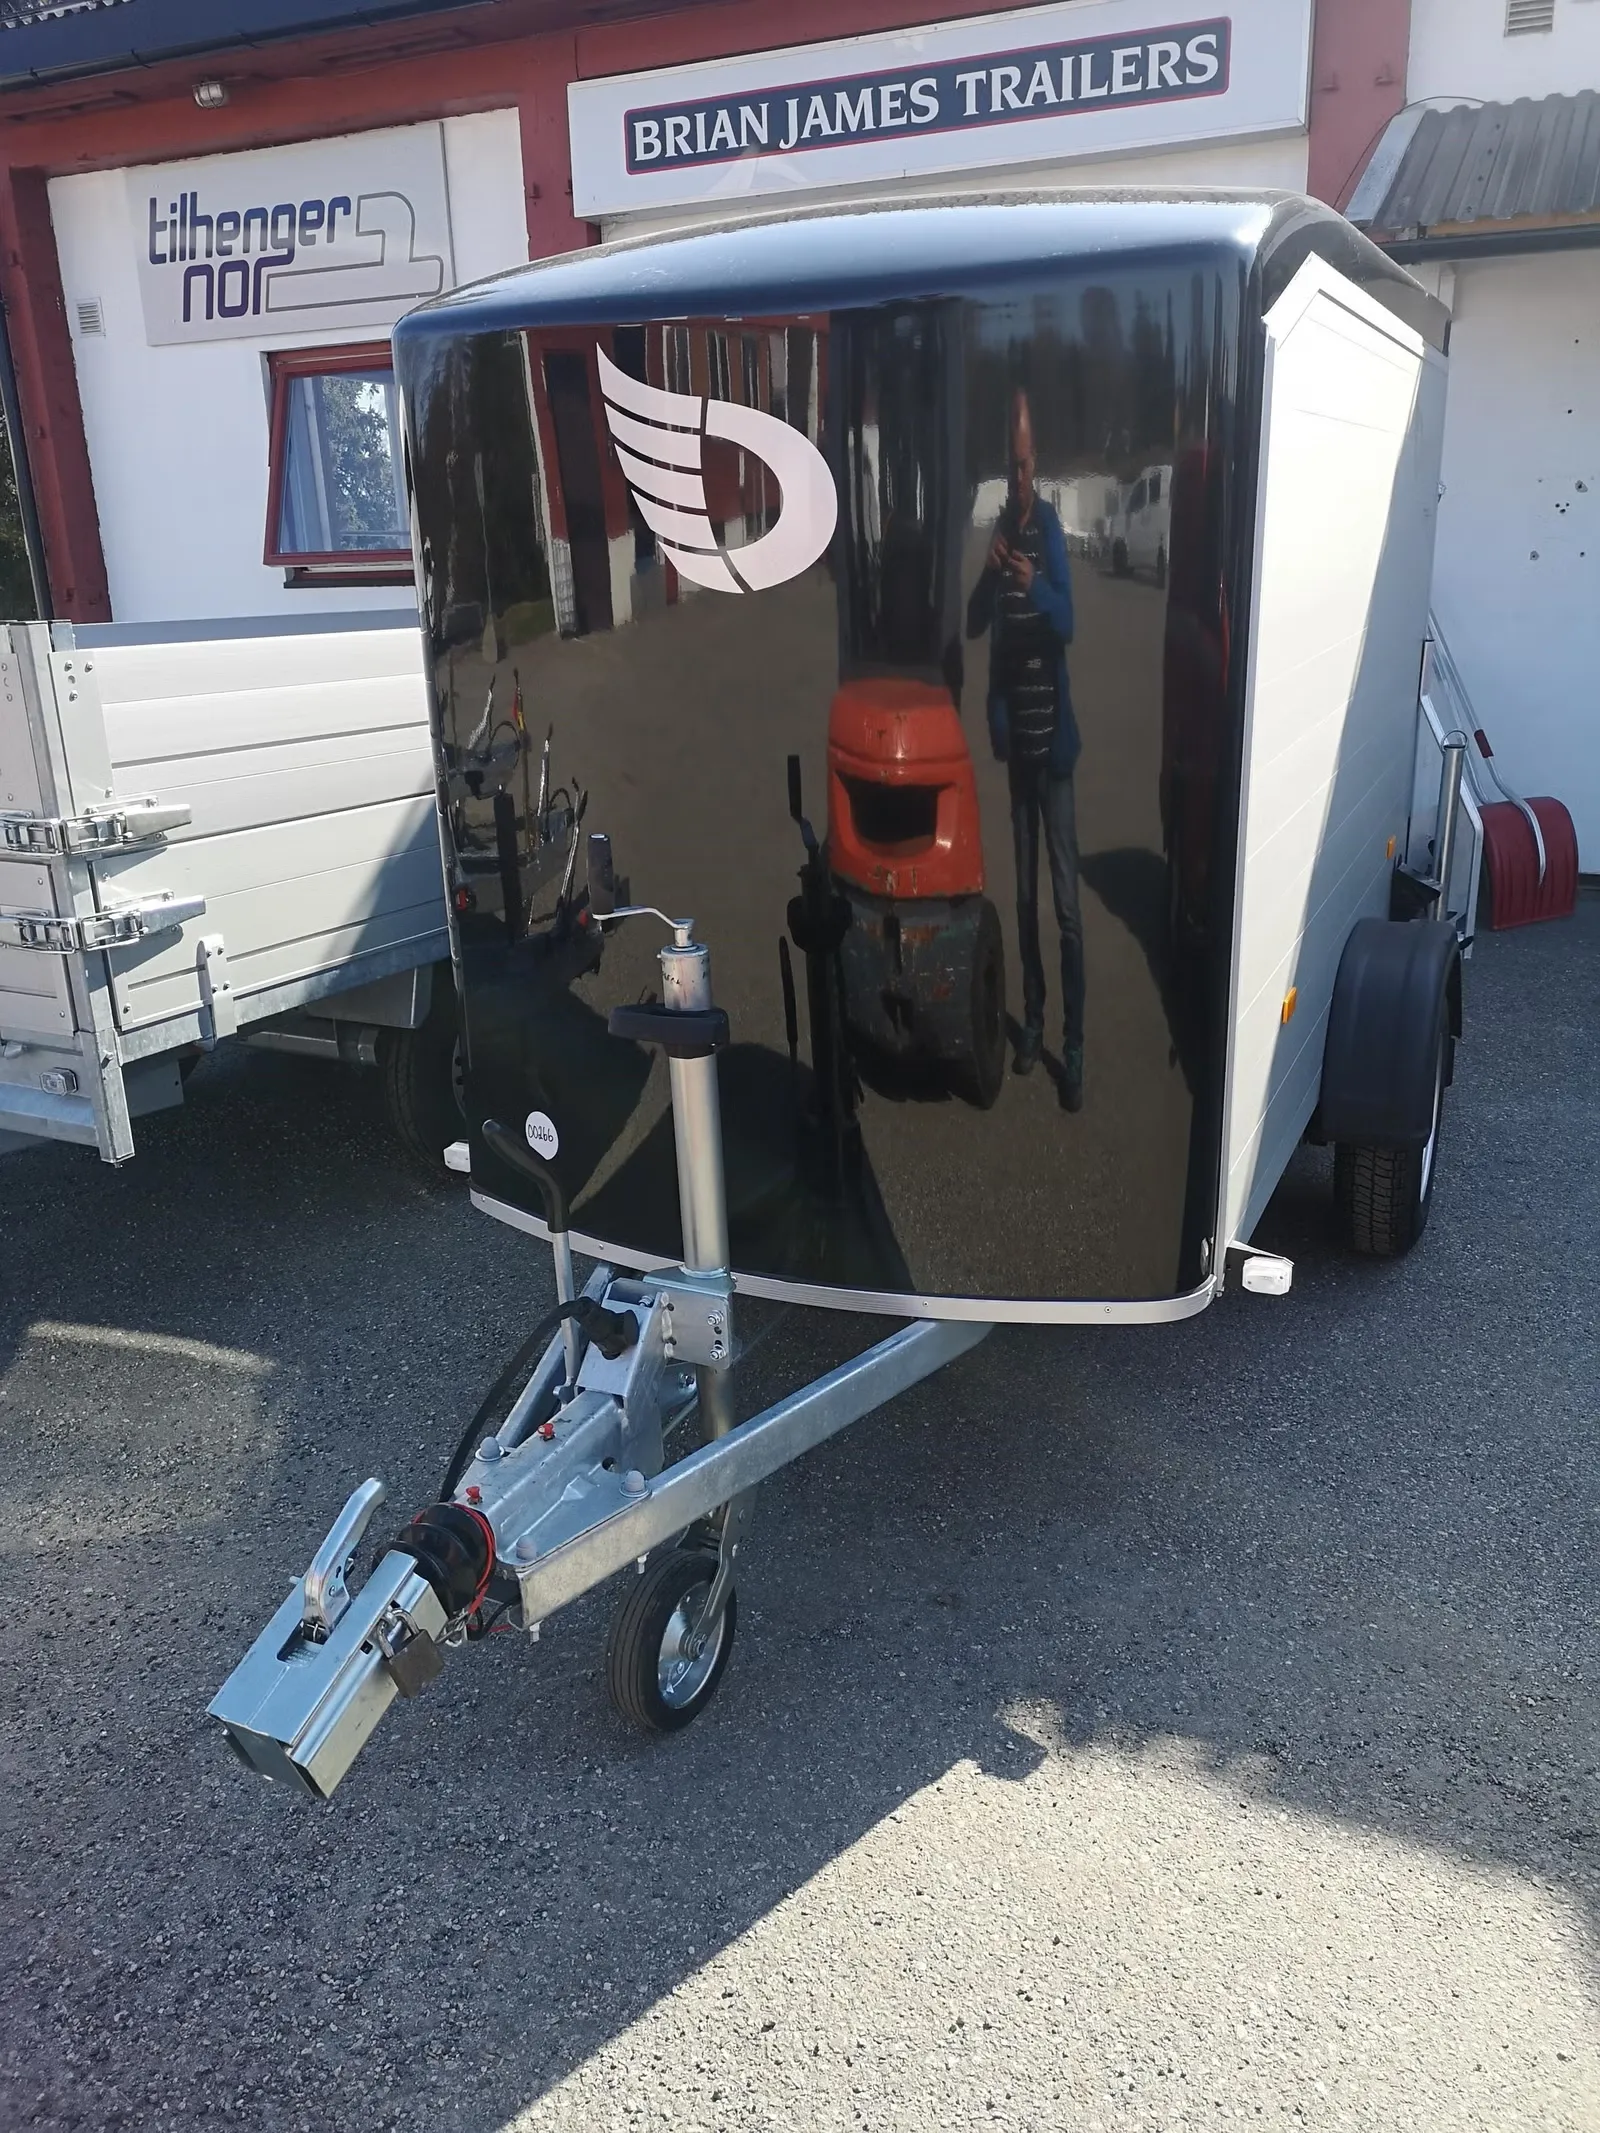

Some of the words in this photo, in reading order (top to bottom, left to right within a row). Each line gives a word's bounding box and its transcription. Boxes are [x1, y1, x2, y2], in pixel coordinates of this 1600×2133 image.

[633, 102, 769, 161] BRIAN
[778, 78, 939, 150] JAMES
[955, 34, 1219, 117] TRAILERS
[149, 191, 351, 266] tilhenger
[183, 257, 294, 323] nor
